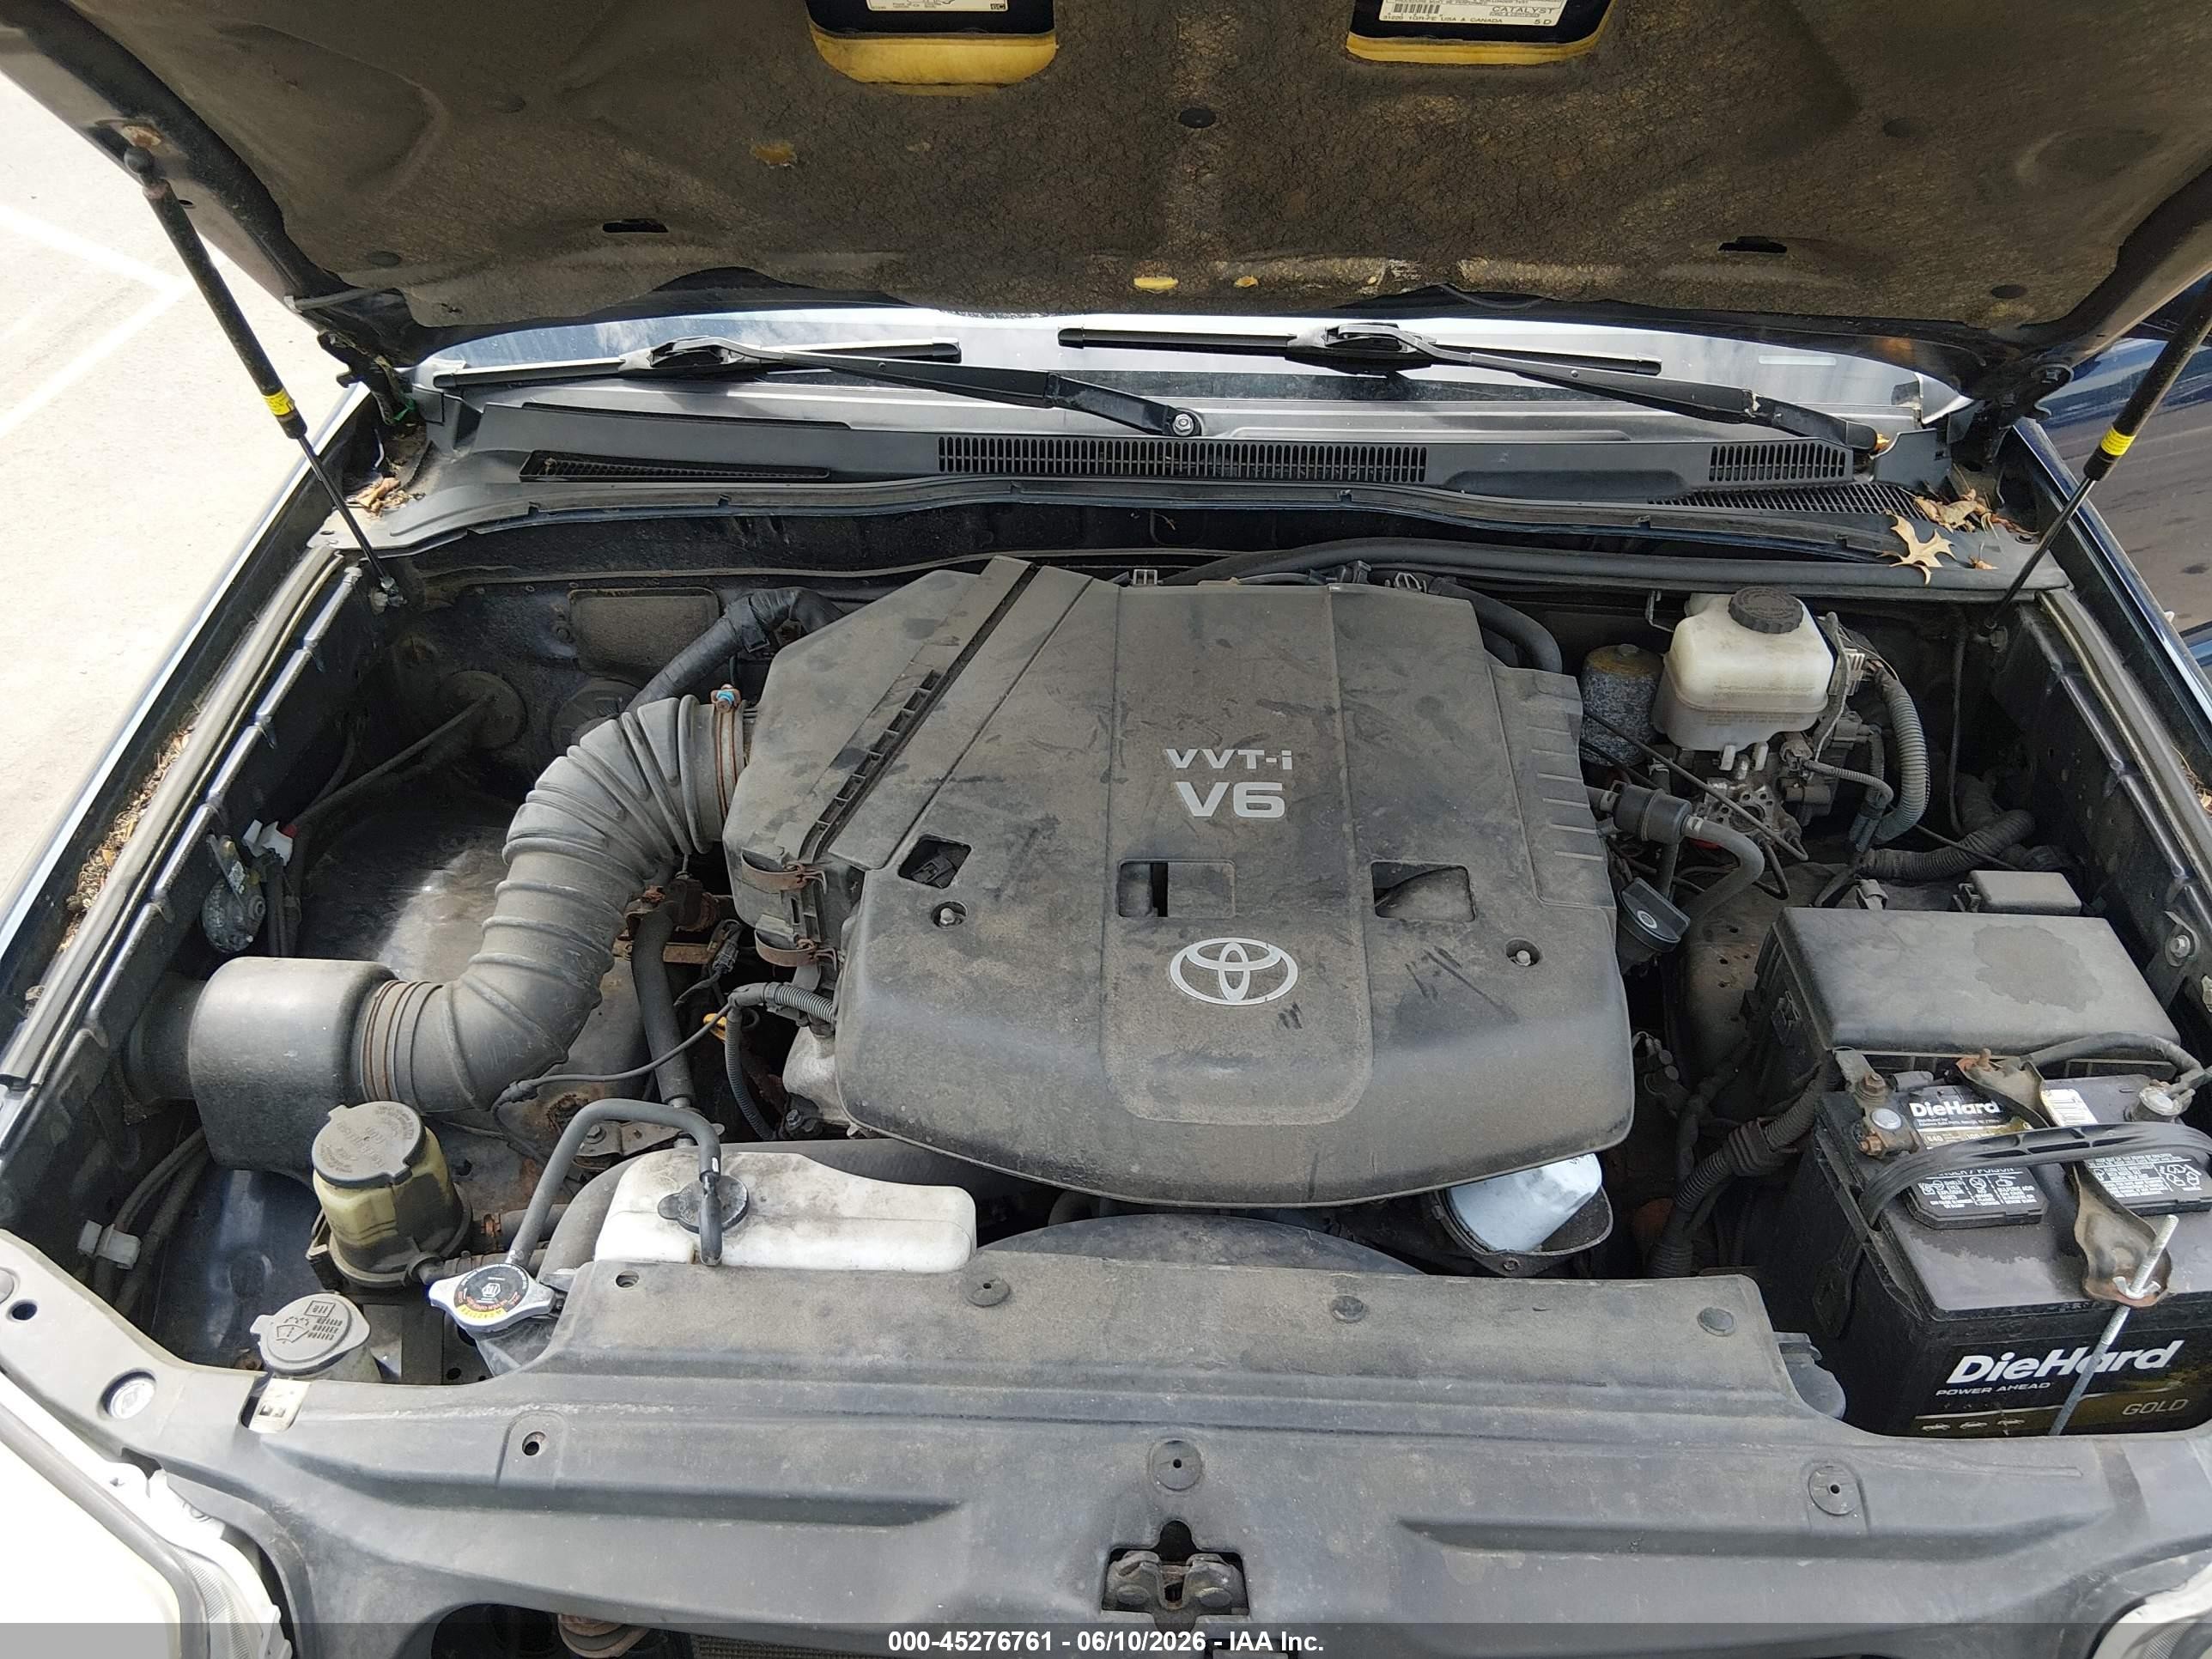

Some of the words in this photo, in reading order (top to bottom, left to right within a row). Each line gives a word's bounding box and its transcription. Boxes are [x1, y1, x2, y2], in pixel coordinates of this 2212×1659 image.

[1165, 749, 1292, 770] VVT-i
[1175, 781, 1285, 818] V6
[1909, 1100, 2001, 1117] DieHard
[1945, 1340, 2185, 1384] DieHard
[1936, 1387, 1992, 1396] POWER
[1996, 1382, 2051, 1392] AHEAD
[2122, 1399, 2190, 1416] GOLD
